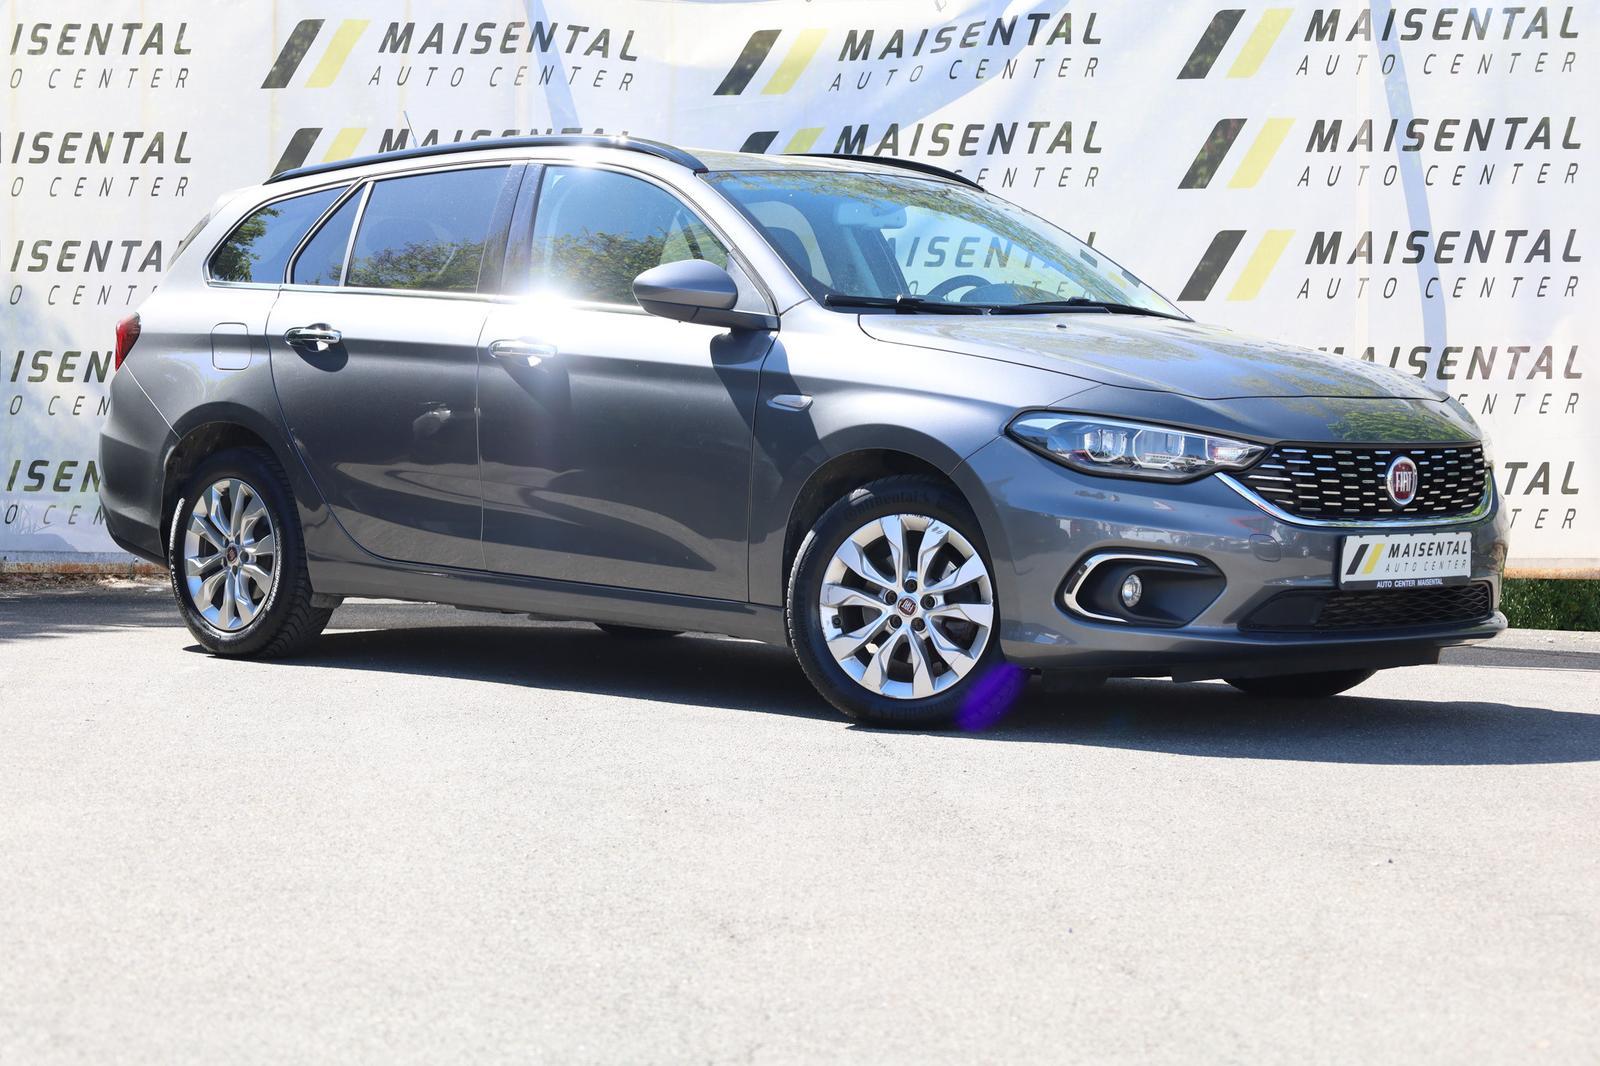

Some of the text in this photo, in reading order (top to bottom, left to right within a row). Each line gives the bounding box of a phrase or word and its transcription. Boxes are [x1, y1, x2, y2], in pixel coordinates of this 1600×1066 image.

[838, 12, 1102, 62] MAISENTAL
[1304, 6, 1579, 43] MAISENTAL
[378, 21, 638, 62] MAISENTAL
[829, 57, 1099, 92] AUTO CENTER
[1296, 51, 1577, 76] AUTO CENTER
[49, 67, 189, 89] CENTER
[368, 65, 634, 92] AUTO CENTER
[833, 121, 1103, 157] MAISENTAL
[1305, 116, 1582, 152] MAISENTAL
[0, 132, 192, 164] ISENTAL
[49, 176, 189, 198] CENTER
[953, 167, 1099, 188] ENTER
[1296, 163, 1579, 187] AUTO CENTER
[10, 240, 184, 273] ISENTA
[1304, 229, 1582, 265] MAISENTAL
[48, 285, 157, 306] CENT
[1297, 276, 1579, 300] AUTO CENTER
[0, 350, 113, 383] ISEN
[1395, 470, 1413, 492] FIAT
[1388, 540, 1468, 558] MAISENTAL
[1386, 559, 1466, 574] AUTO CENTER
[1377, 578, 1443, 588] AUTO CENTER MAISENTAL
